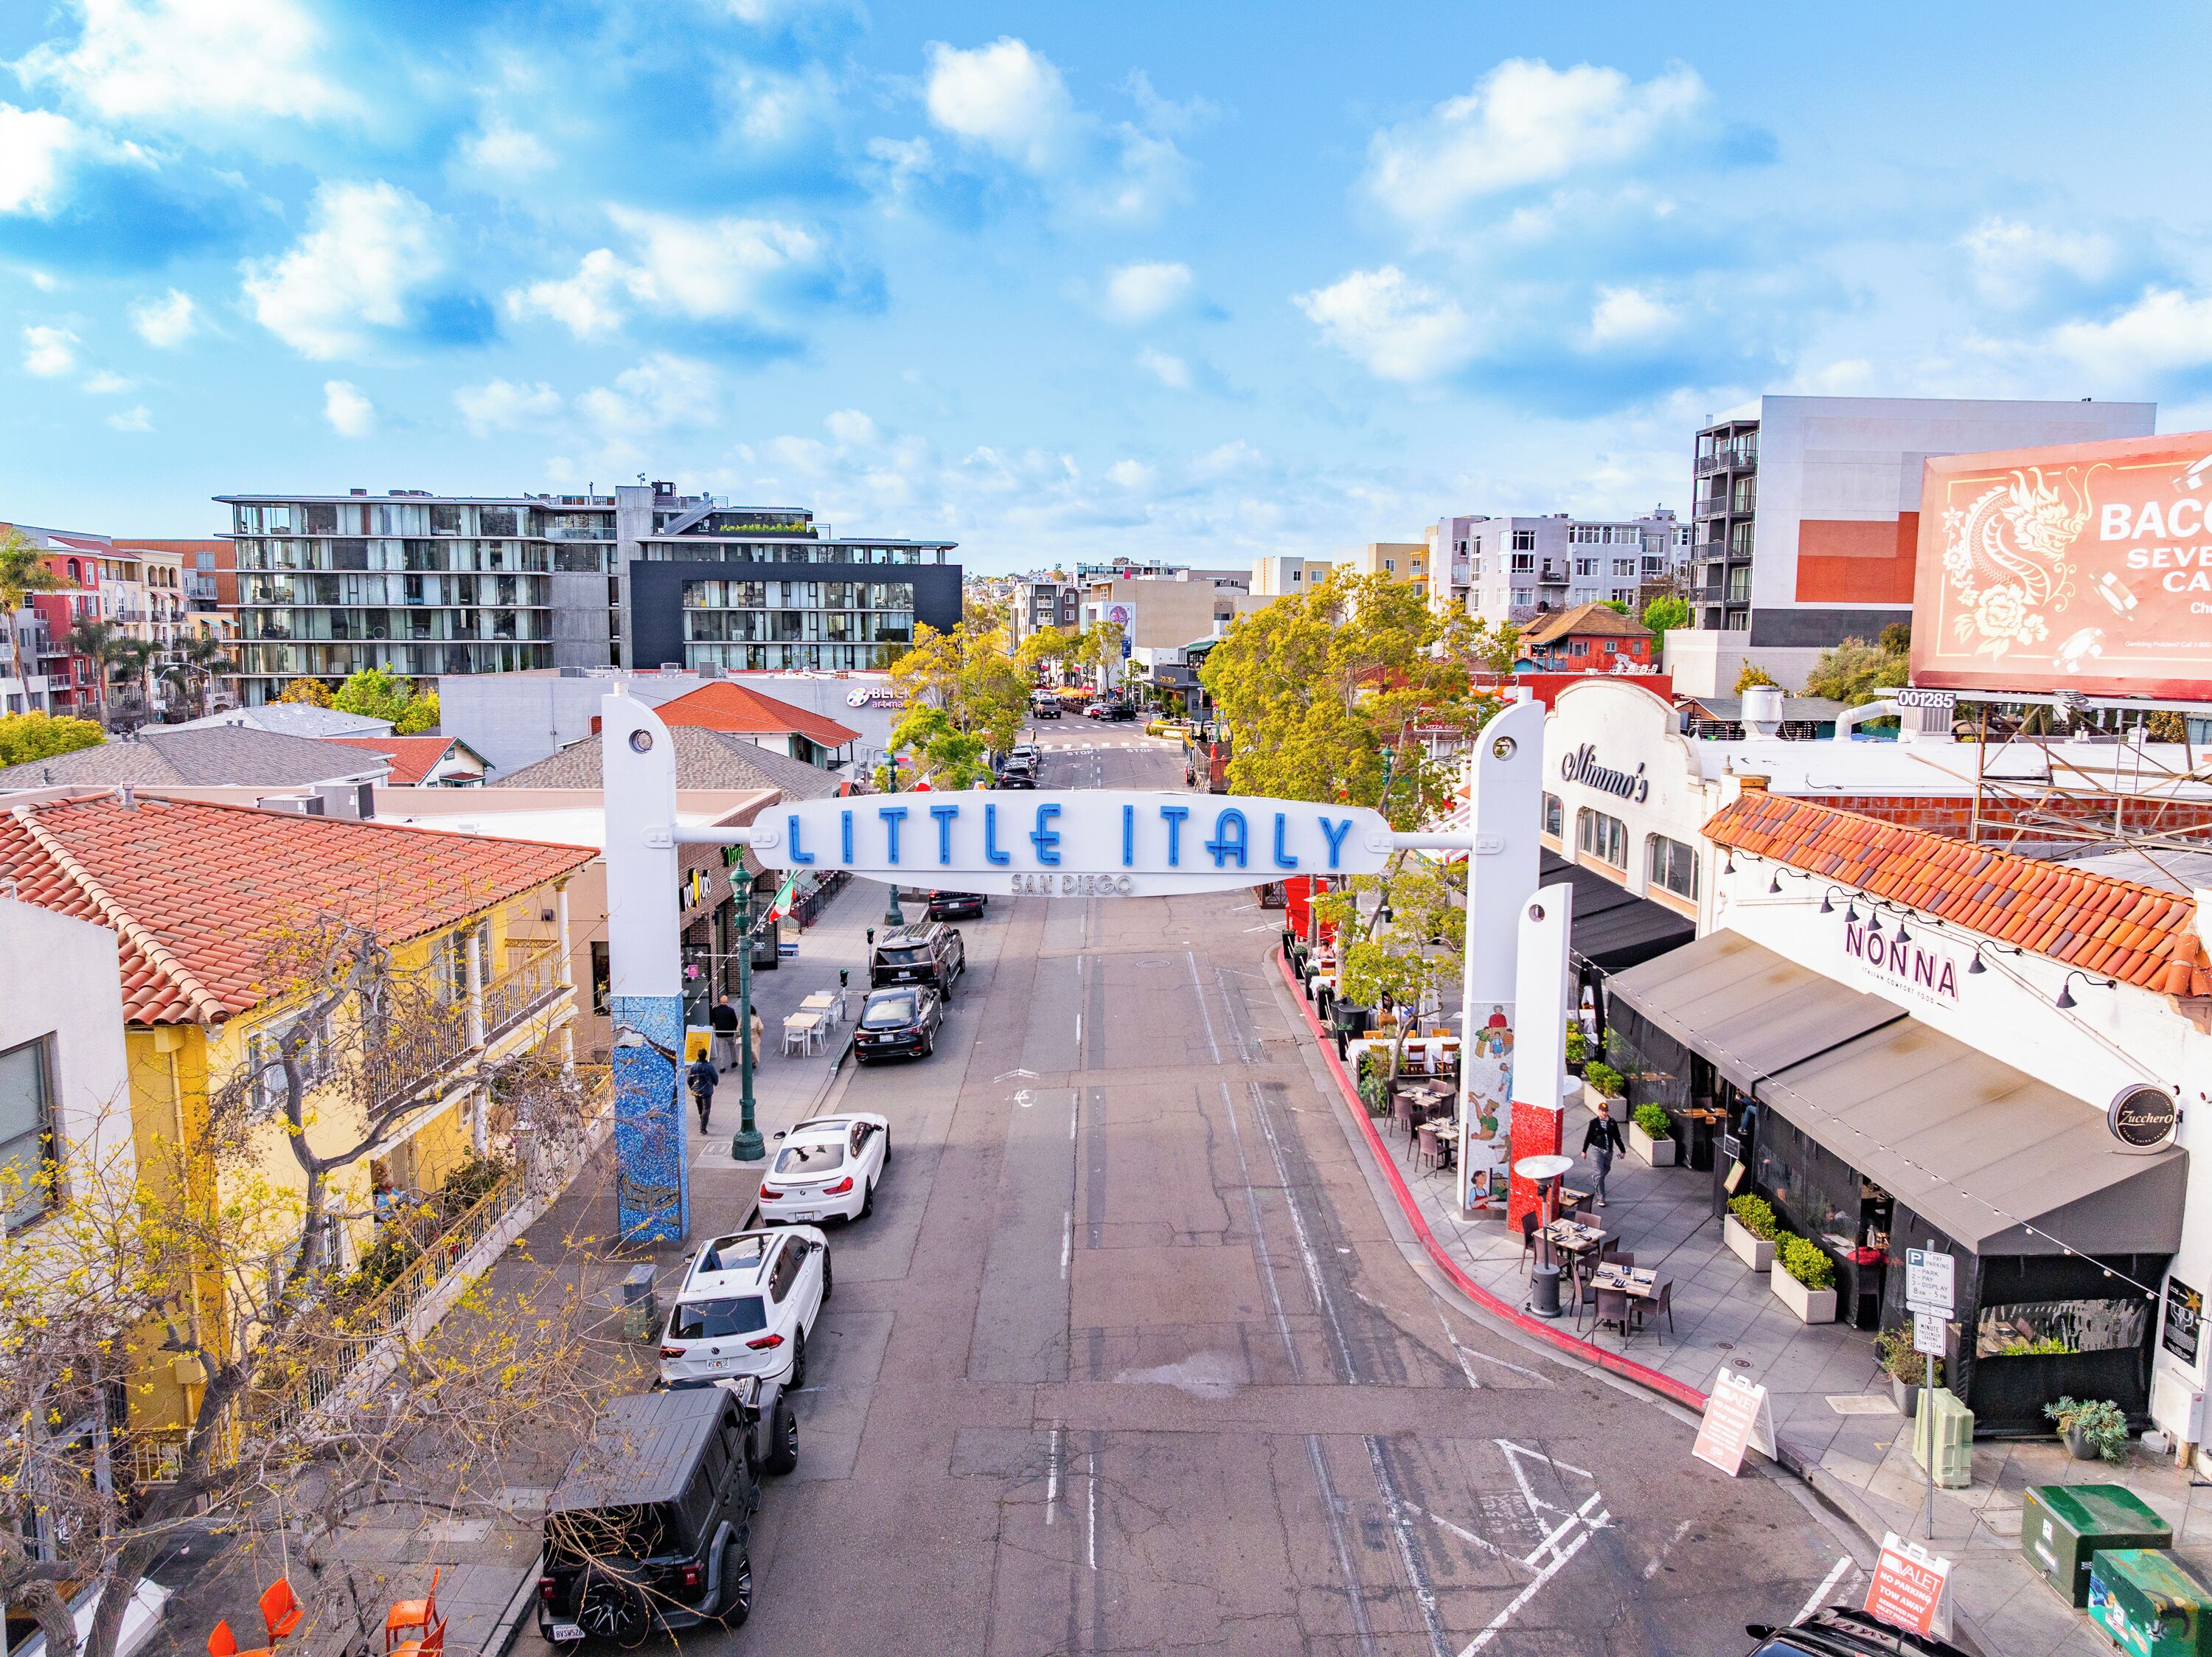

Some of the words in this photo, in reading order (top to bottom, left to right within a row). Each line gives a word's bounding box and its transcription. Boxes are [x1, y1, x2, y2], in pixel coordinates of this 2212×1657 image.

[2100, 499, 2212, 541] BAC
[2126, 546, 2212, 569] SEVE
[2163, 571, 2211, 592] CA
[2124, 640, 2152, 649] Gambling
[1898, 690, 1954, 709] 001285
[1562, 743, 1649, 803] Mimmo's
[787, 803, 1061, 865] LITTLE
[1122, 805, 1353, 868] ITALY
[1011, 874, 1053, 895] SAN
[1062, 875, 1133, 896] DIEGO
[1846, 923, 1958, 1001] NONNA
[1862, 967, 1884, 982] ITALIAN
[1887, 978, 1914, 994] COMFORT
[1917, 991, 1934, 1004] FOOD
[2118, 1110, 2174, 1126] Zucchero
[1910, 1252, 1921, 1263] P
[1926, 1261, 1950, 1270] PARKING
[1922, 1268, 1938, 1277] PARK
[1921, 1282, 1948, 1292] DISPLAY
[1919, 1330, 1941, 1338] PASSENGER
[1920, 1324, 1939, 1333] MINUTE
[1898, 1559, 1941, 1593] VALET
[1879, 1571, 1893, 1583] NO
[1893, 1578, 1932, 1604] PARKING
[1876, 1602, 1893, 1615] VALET
[1879, 1584, 1900, 1601] TOW
[1899, 1597, 1926, 1614] AWAY
[1878, 1597, 1907, 1616] RESERVED
[1906, 1612, 1919, 1623] FOR
[556, 1629, 583, 1638] 8VSW526
